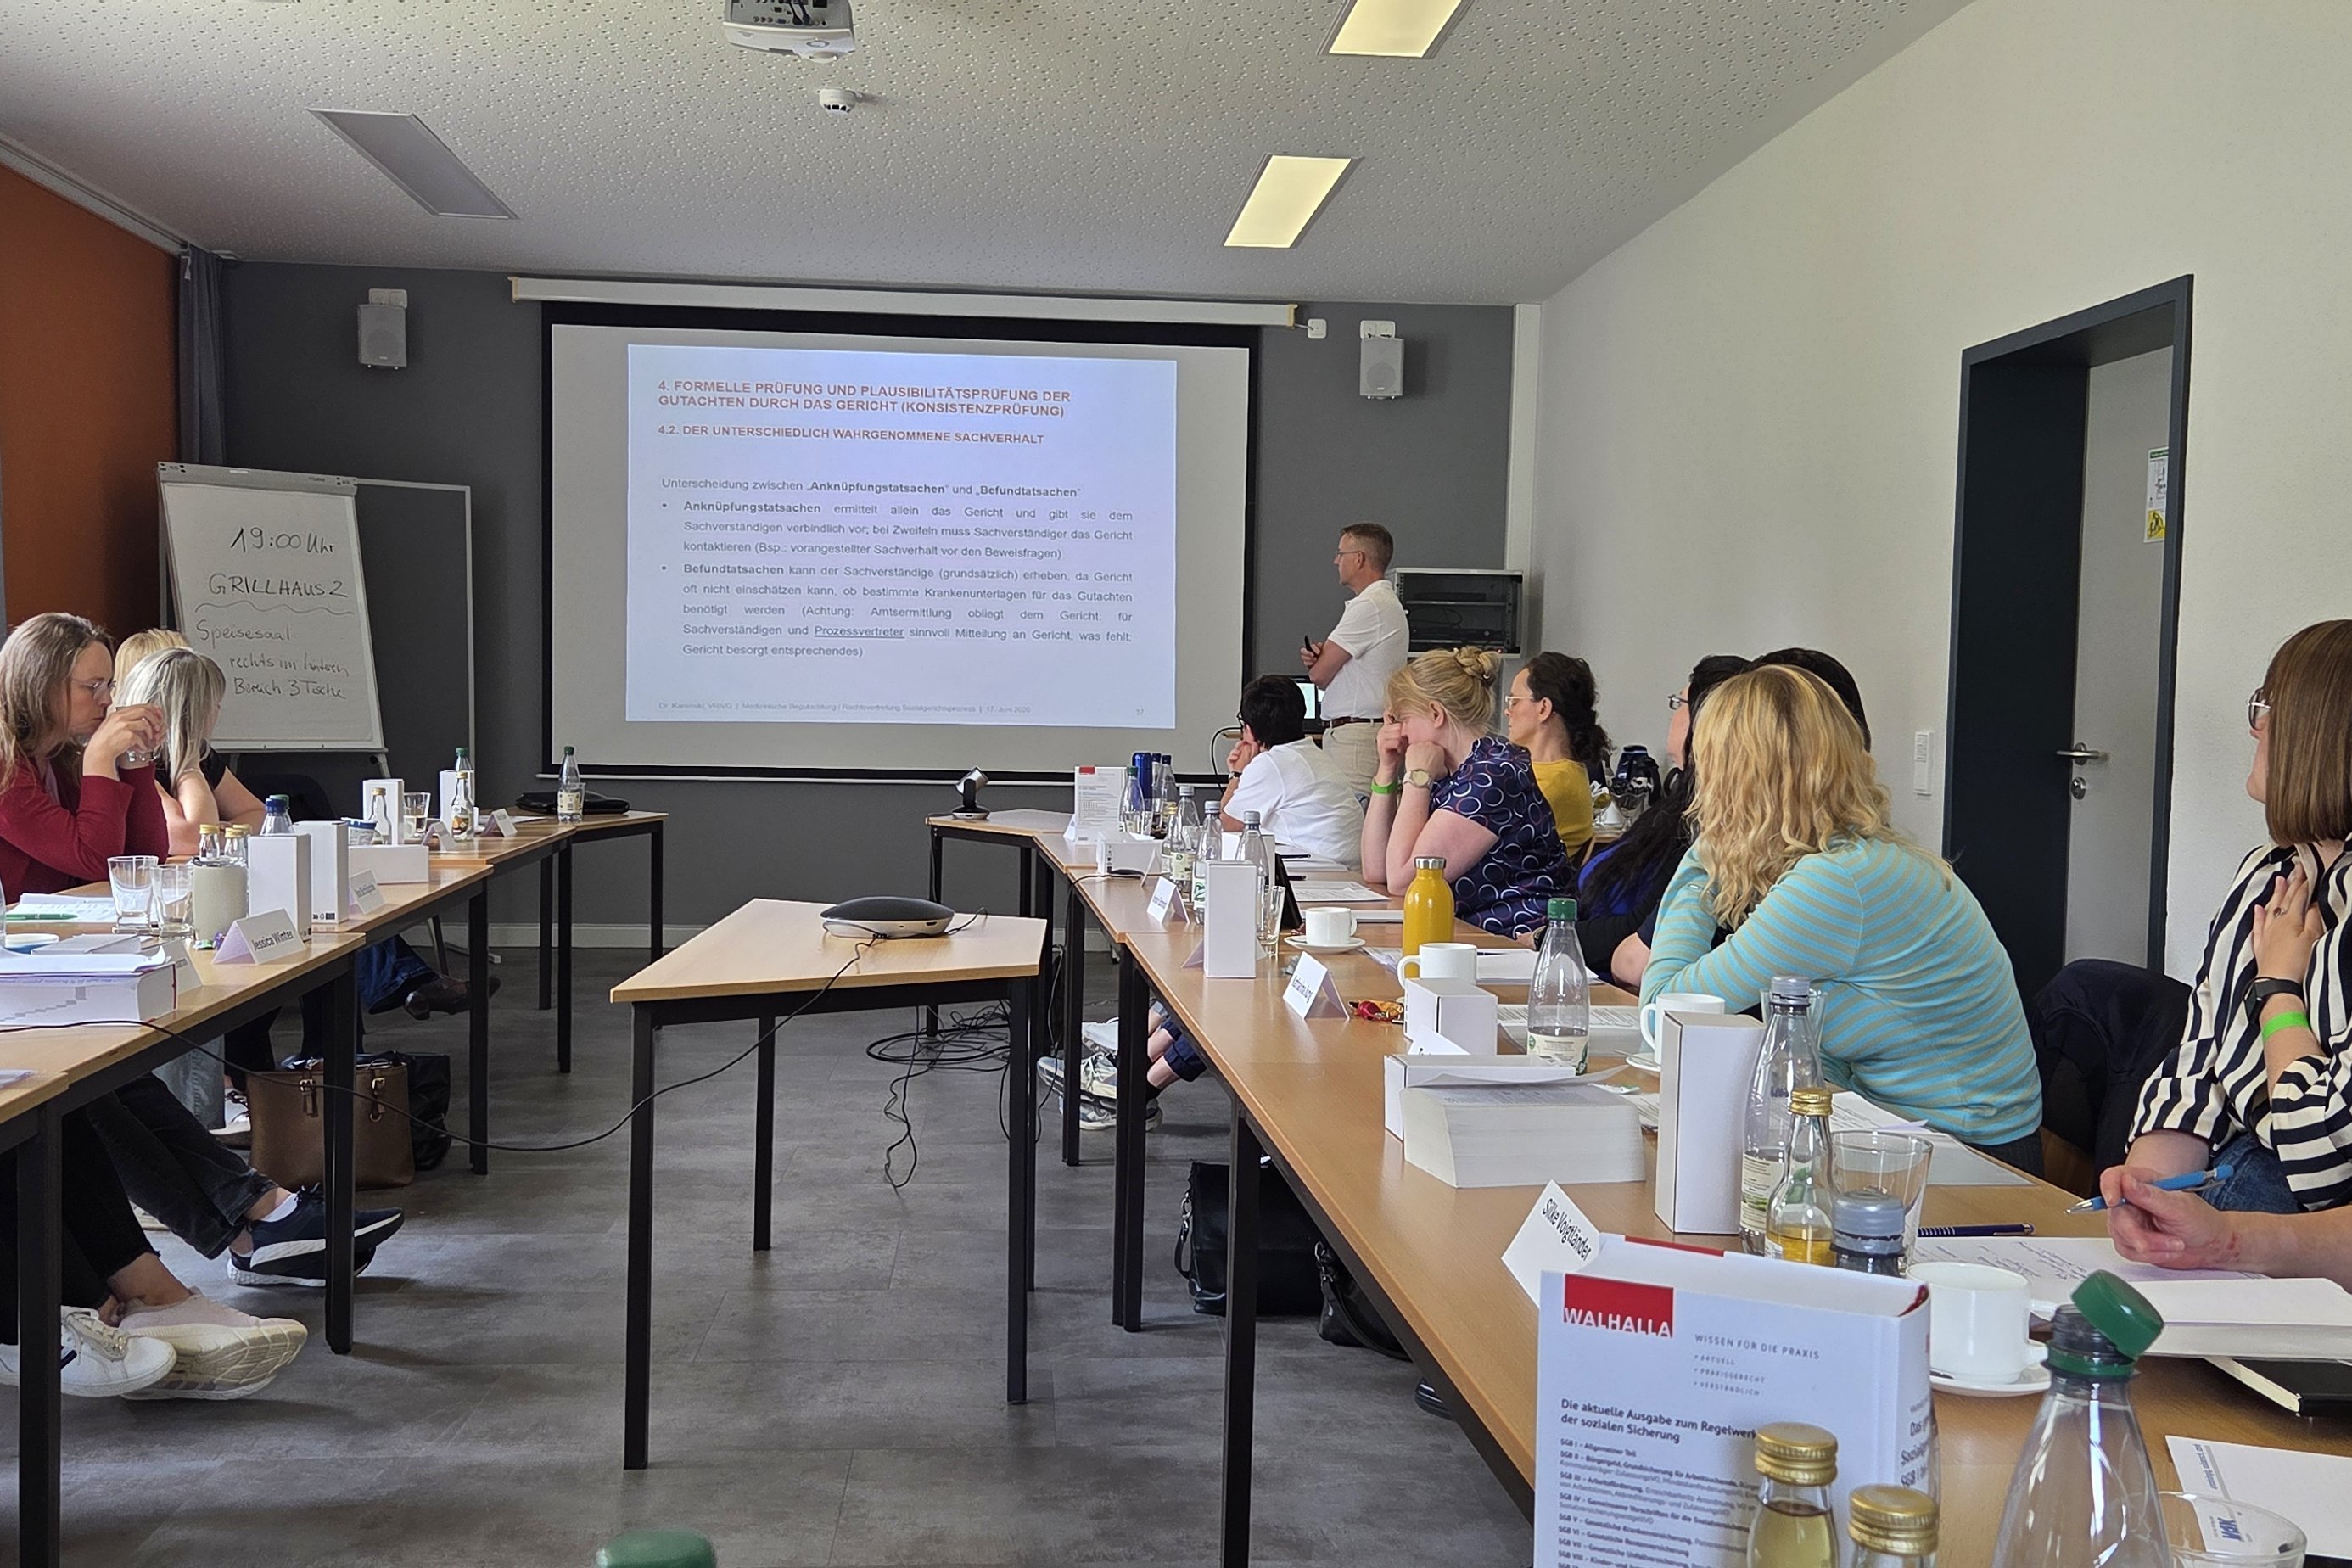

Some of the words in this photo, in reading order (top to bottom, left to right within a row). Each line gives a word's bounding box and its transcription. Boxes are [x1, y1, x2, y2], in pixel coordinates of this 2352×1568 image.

[658, 381, 670, 392] 4.
[675, 380, 751, 394] FORMELLE
[755, 381, 822, 395] PRÜFUNG
[827, 384, 856, 396] UND
[860, 385, 1038, 401] PLAUSIBILITÄTSPRÜFUNG
[1043, 390, 1071, 402] DER
[658, 395, 745, 408] GUTACHTEN
[749, 397, 799, 409] DURCH
[804, 399, 832, 410] DAS
[836, 400, 898, 412] GERICHT
[901, 402, 1064, 418] (KONSISTENZPRÜFUNG)
[658, 425, 679, 435] 4.2.
[683, 425, 709, 436] DER
[713, 426, 830, 439] UNTERSCHIEDLICH
[833, 428, 951, 441] WAHRGENOMMENE
[955, 432, 1044, 444] SACHVERHALT
[662, 479, 748, 491] Unterscheidung
[752, 479, 803, 490] zwischen
[952, 485, 972, 495] und
[684, 501, 821, 514] Anknüpfungstatsachen
[834, 505, 878, 514] ermittelt
[890, 506, 919, 516] allein
[932, 507, 951, 516] das
[964, 507, 1004, 518] Gericht
[1016, 509, 1036, 518] und
[1049, 510, 1068, 522] gibt
[1081, 511, 1096, 520] sie
[1109, 511, 1133, 521] dem
[230, 526, 302, 554] 19:00
[306, 532, 335, 554] Uhr
[684, 521, 783, 535] Sachverständigen
[787, 524, 845, 534] verbindlich
[872, 525, 890, 535] bei
[893, 526, 938, 536] Zweifeln
[973, 527, 1067, 541] Sachverständiger
[1071, 529, 1090, 539] das
[1094, 530, 1134, 540] Gericht
[684, 541, 751, 552] kontaktieren
[791, 544, 871, 555] vorangestellter
[874, 544, 938, 556] Sachverhalt
[942, 547, 958, 556] vor
[961, 546, 982, 557] den
[985, 547, 1061, 560] Beweisfragen)
[683, 564, 784, 575] Befundtatsachen
[788, 566, 816, 575] kann
[820, 566, 839, 575] der
[843, 566, 934, 579] Sachverständige
[938, 568, 1018, 581] (grundsätzlich)
[1075, 572, 1089, 581] da
[1094, 572, 1133, 582] Gericht
[683, 584, 697, 594] oft
[703, 585, 730, 595] nicht
[735, 585, 802, 596] einschätzen
[843, 586, 857, 596] ob
[862, 587, 919, 597] bestimmte
[925, 588, 1027, 602] Krankenunterlagen
[1032, 591, 1046, 600] für
[1051, 591, 1072, 601] das
[1077, 591, 1133, 602] Gutachten
[683, 604, 728, 616] benötigt
[744, 605, 785, 615] werden
[870, 607, 952, 619] Amtsermittlung
[967, 608, 1004, 620] obliegt
[1020, 610, 1044, 619] dem
[1118, 613, 1133, 622] für
[196, 619, 292, 649] Speisesaal
[683, 624, 782, 636] Sachverständigen
[788, 626, 809, 636] und
[814, 625, 904, 638] Prozessvertreter
[909, 628, 950, 638] sinnvoll
[955, 628, 1007, 641] Mitteilung
[1012, 631, 1026, 640] an
[1079, 632, 1100, 641] was
[683, 644, 723, 655] Gericht
[726, 645, 769, 657] besorgt
[771, 646, 864, 658] entsprechendes)
[1542, 1197, 1560, 1225] Silke
[1556, 1211, 1592, 1261] Voigtländer
[1563, 1306, 1673, 1339] WALHALLA
[1694, 1334, 1733, 1347] WISSEN
[1737, 1338, 1757, 1350] FÜR
[1761, 1342, 1778, 1353] DIE
[1782, 1346, 1820, 1359] PRAXIS
[1561, 1398, 1579, 1411] Die
[1582, 1401, 1624, 1419] aktuelle
[1627, 1408, 1672, 1425] Ausgabe
[1675, 1419, 1698, 1431] zum
[1561, 1414, 1579, 1425] der
[1582, 1416, 1624, 1433] sozialen
[1627, 1423, 1681, 1444] Sicherung
